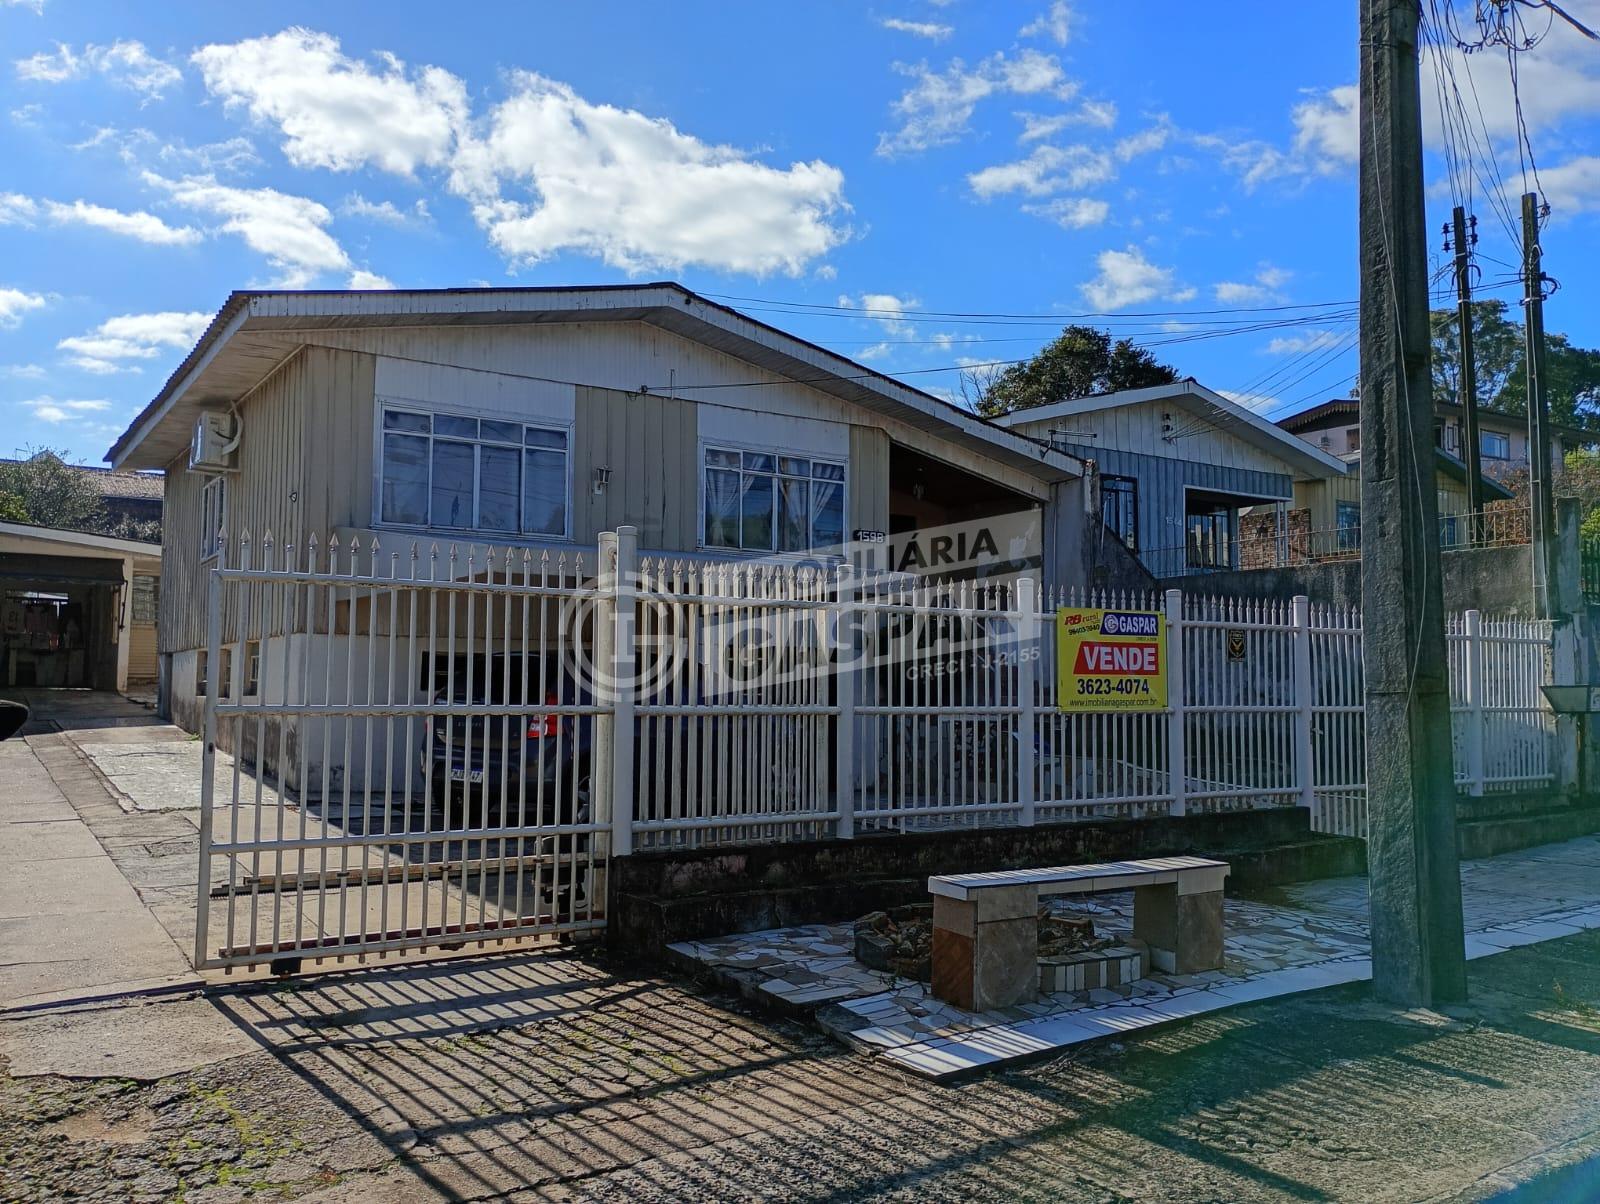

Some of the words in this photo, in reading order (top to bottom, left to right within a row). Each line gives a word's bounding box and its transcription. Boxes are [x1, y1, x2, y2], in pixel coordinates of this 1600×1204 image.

[858, 531, 884, 543] 1598
[1119, 616, 1157, 633] GASPAR
[1083, 646, 1156, 671] VENDE
[1077, 678, 1150, 695] 3623-4074
